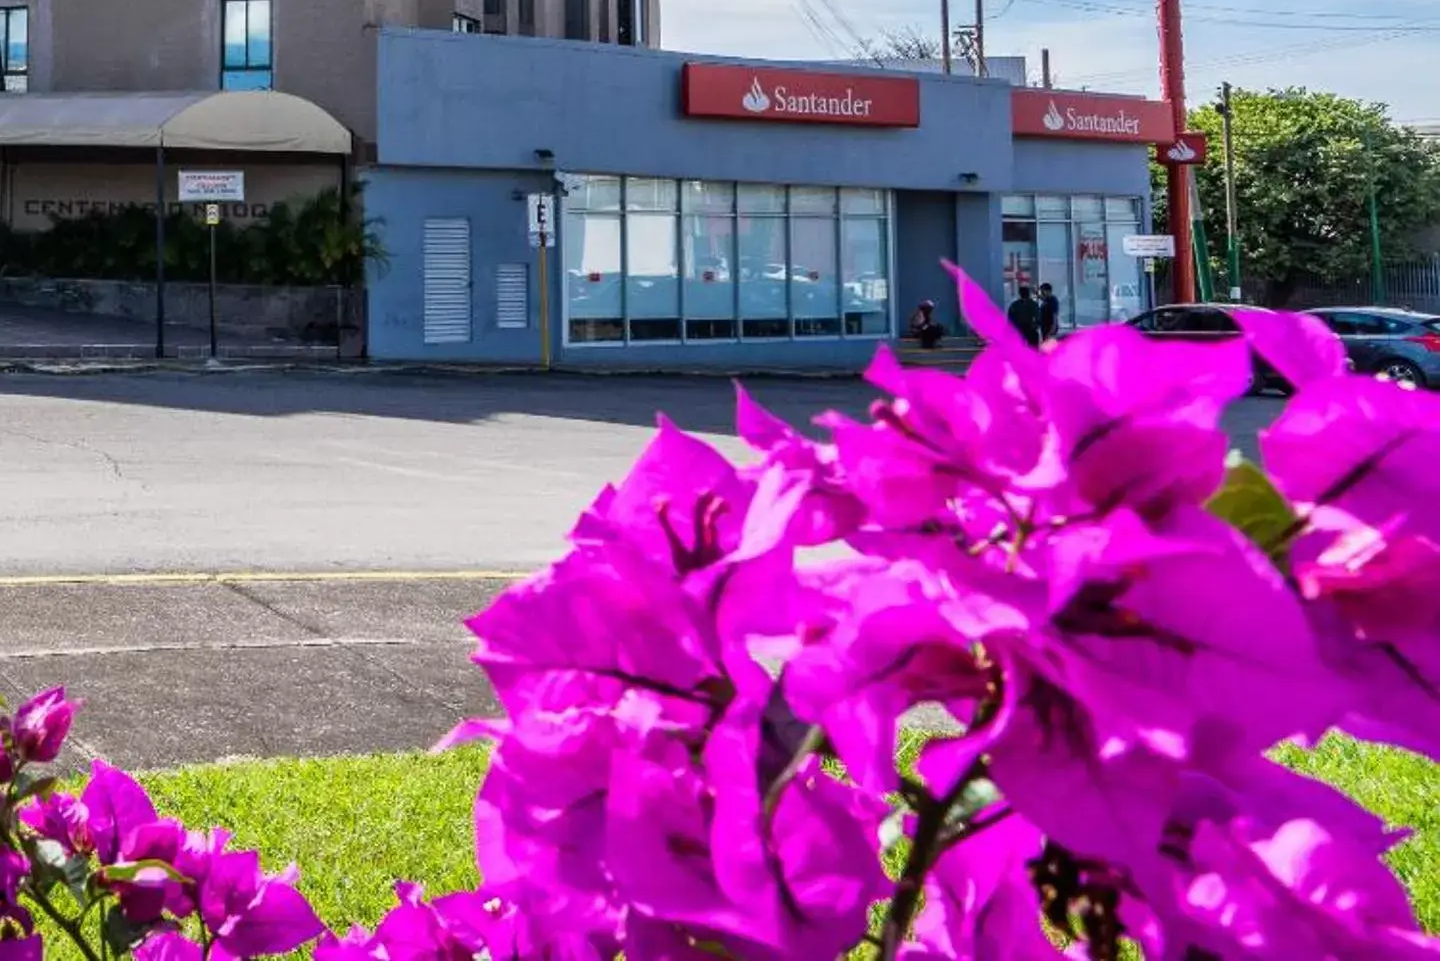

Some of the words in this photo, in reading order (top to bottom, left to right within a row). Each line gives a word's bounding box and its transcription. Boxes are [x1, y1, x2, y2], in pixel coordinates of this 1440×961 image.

[774, 86, 872, 116] Santander
[1067, 107, 1139, 134] Santander
[24, 199, 182, 218] CENTENRO
